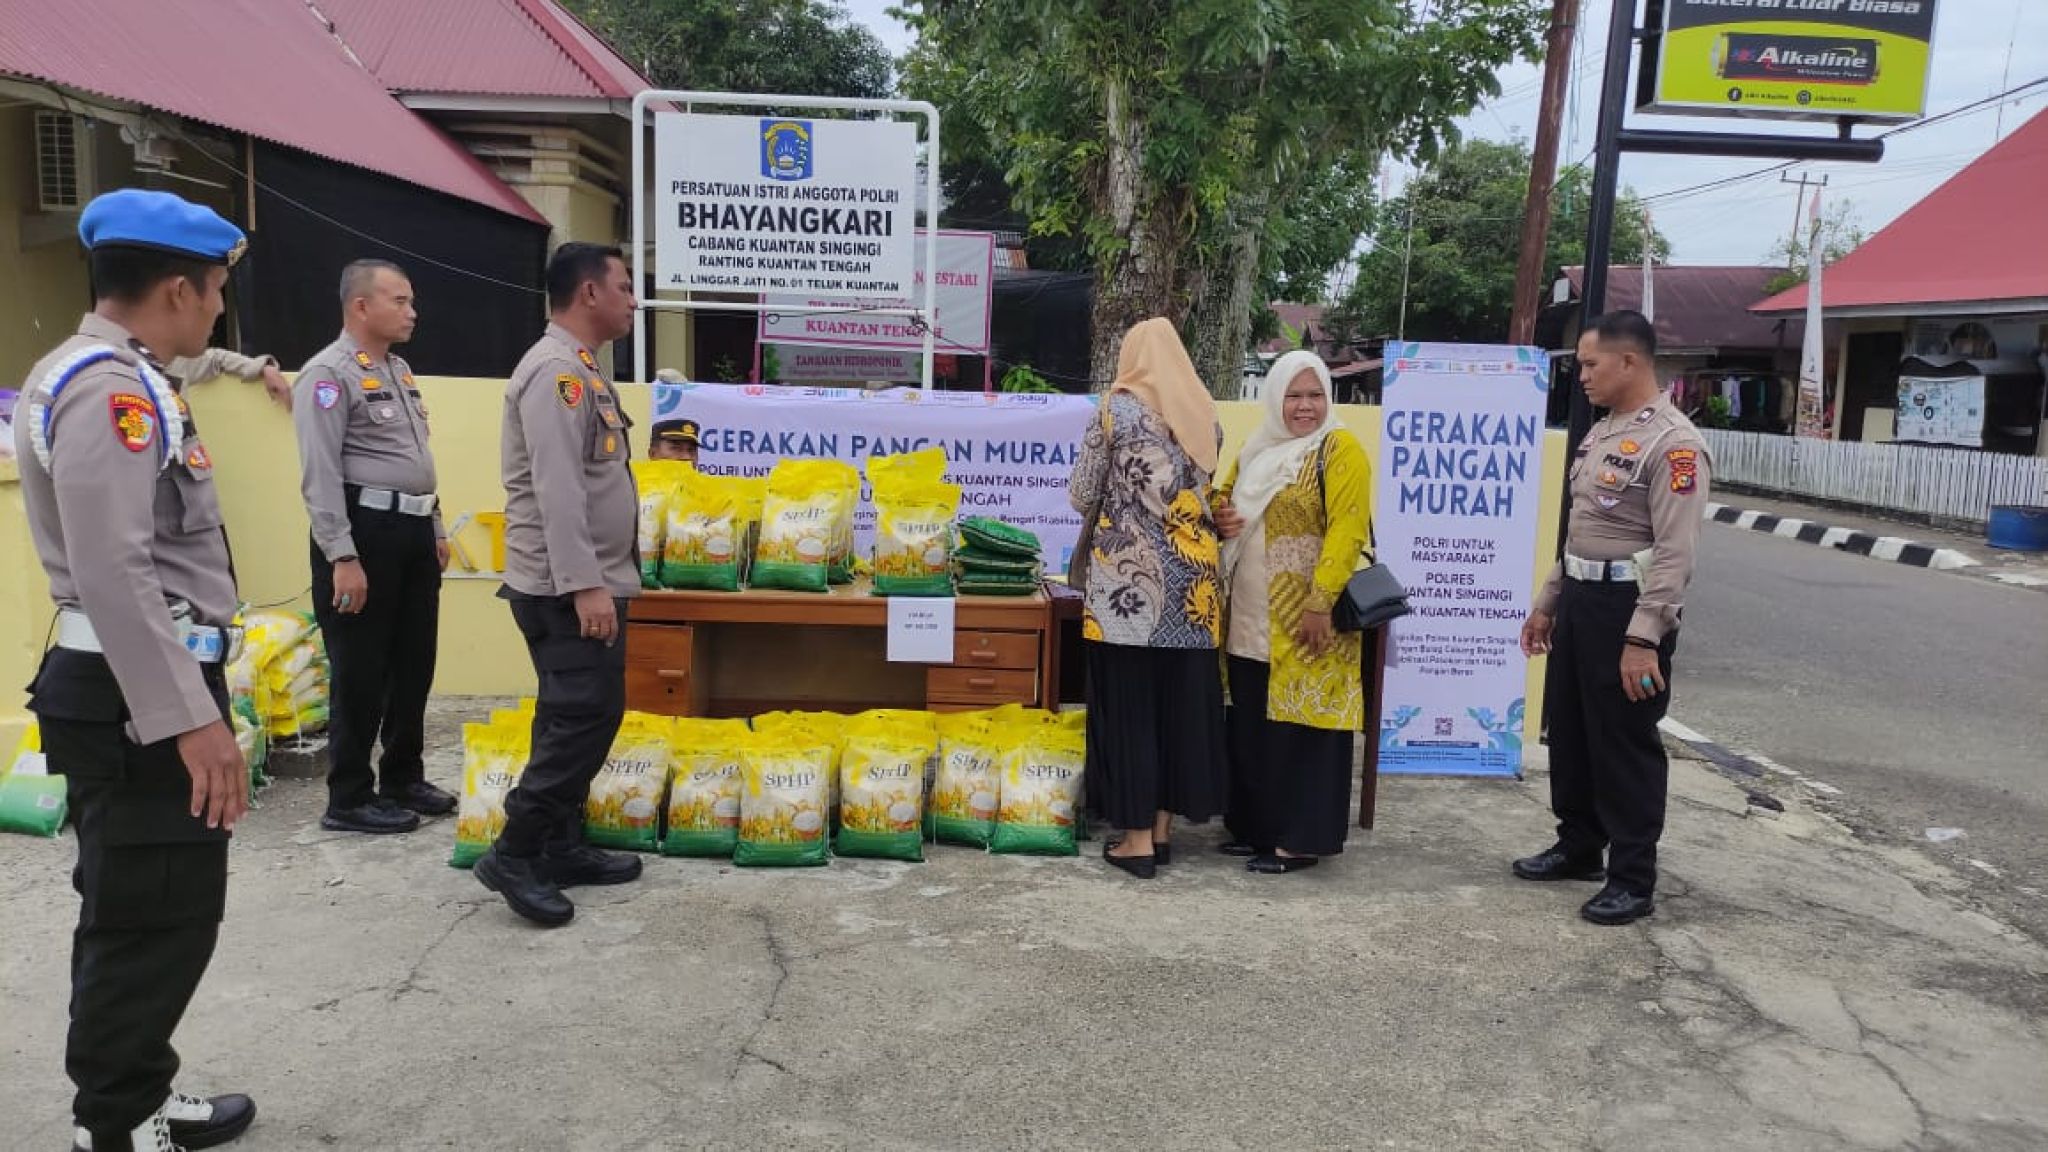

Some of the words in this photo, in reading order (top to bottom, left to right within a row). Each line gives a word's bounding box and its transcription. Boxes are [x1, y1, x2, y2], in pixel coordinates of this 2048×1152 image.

[1757, 47, 1868, 68] Alkaline
[672, 181, 750, 198] PERSATUAN
[754, 184, 789, 199] ISTRI
[793, 186, 857, 202] ANGGOTA
[860, 189, 899, 203] POLRI
[678, 202, 893, 237] BHAYANGKARI
[688, 236, 745, 252] CABANG
[750, 239, 815, 255] KUANTAN
[819, 241, 881, 256] SINGINGI
[699, 256, 754, 269] RANTING
[758, 257, 817, 271] KUANTAN
[821, 260, 871, 273] TENGAH
[690, 274, 740, 286] LINGGAR
[744, 277, 766, 288] JATI
[807, 279, 843, 290] TELUK
[847, 281, 899, 292] KUANTAN
[935, 271, 978, 286] ESTARI
[806, 319, 879, 336] KUANTAN
[882, 324, 944, 339] TENGH
[1386, 410, 1536, 447] GERAKAN
[701, 428, 838, 457] GERAKAN
[1392, 446, 1526, 482] PANGAN
[697, 464, 739, 477] POLRI
[743, 465, 771, 478] UNT
[956, 474, 1023, 488] KUANTAN
[1027, 475, 1071, 488] SINGIN
[962, 492, 1011, 506] NGAH
[1400, 482, 1514, 517] MURAH
[1414, 536, 1450, 549] POLRI
[1452, 538, 1496, 550] UNTUK
[1411, 550, 1496, 564] MASYARAKAT
[1425, 572, 1475, 585] POLRES
[1405, 587, 1452, 600] ANTAN
[1455, 588, 1513, 602] SINGINGI
[1420, 607, 1475, 618] KUANTAN
[1479, 608, 1527, 620] TENGAH
[765, 773, 816, 788] SPHP
[1025, 764, 1073, 780] SPHP
